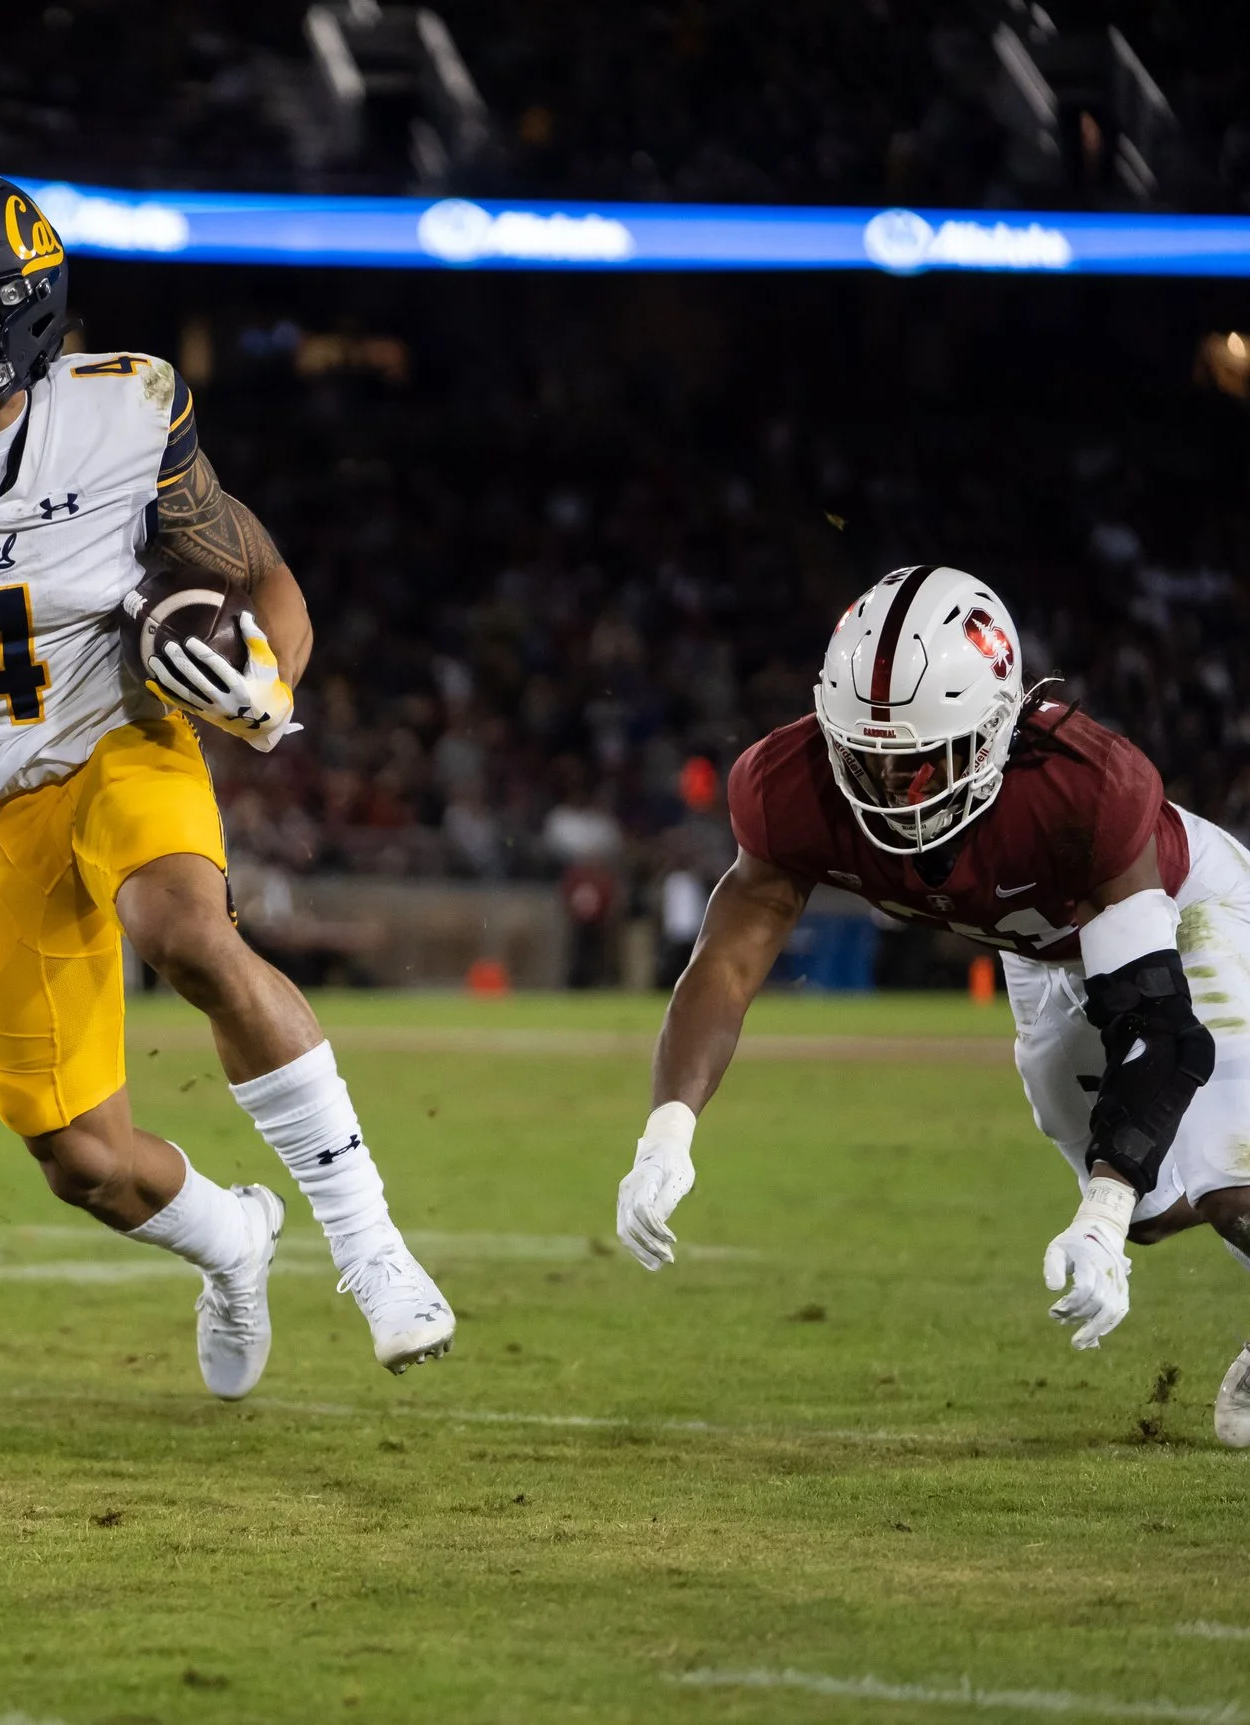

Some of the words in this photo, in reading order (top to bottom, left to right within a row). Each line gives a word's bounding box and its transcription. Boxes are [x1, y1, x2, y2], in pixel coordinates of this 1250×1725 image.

[5, 194, 64, 277] Cal
[70, 354, 152, 378] 4
[961, 747, 991, 779] idell
[901, 823, 927, 831] Ridll
